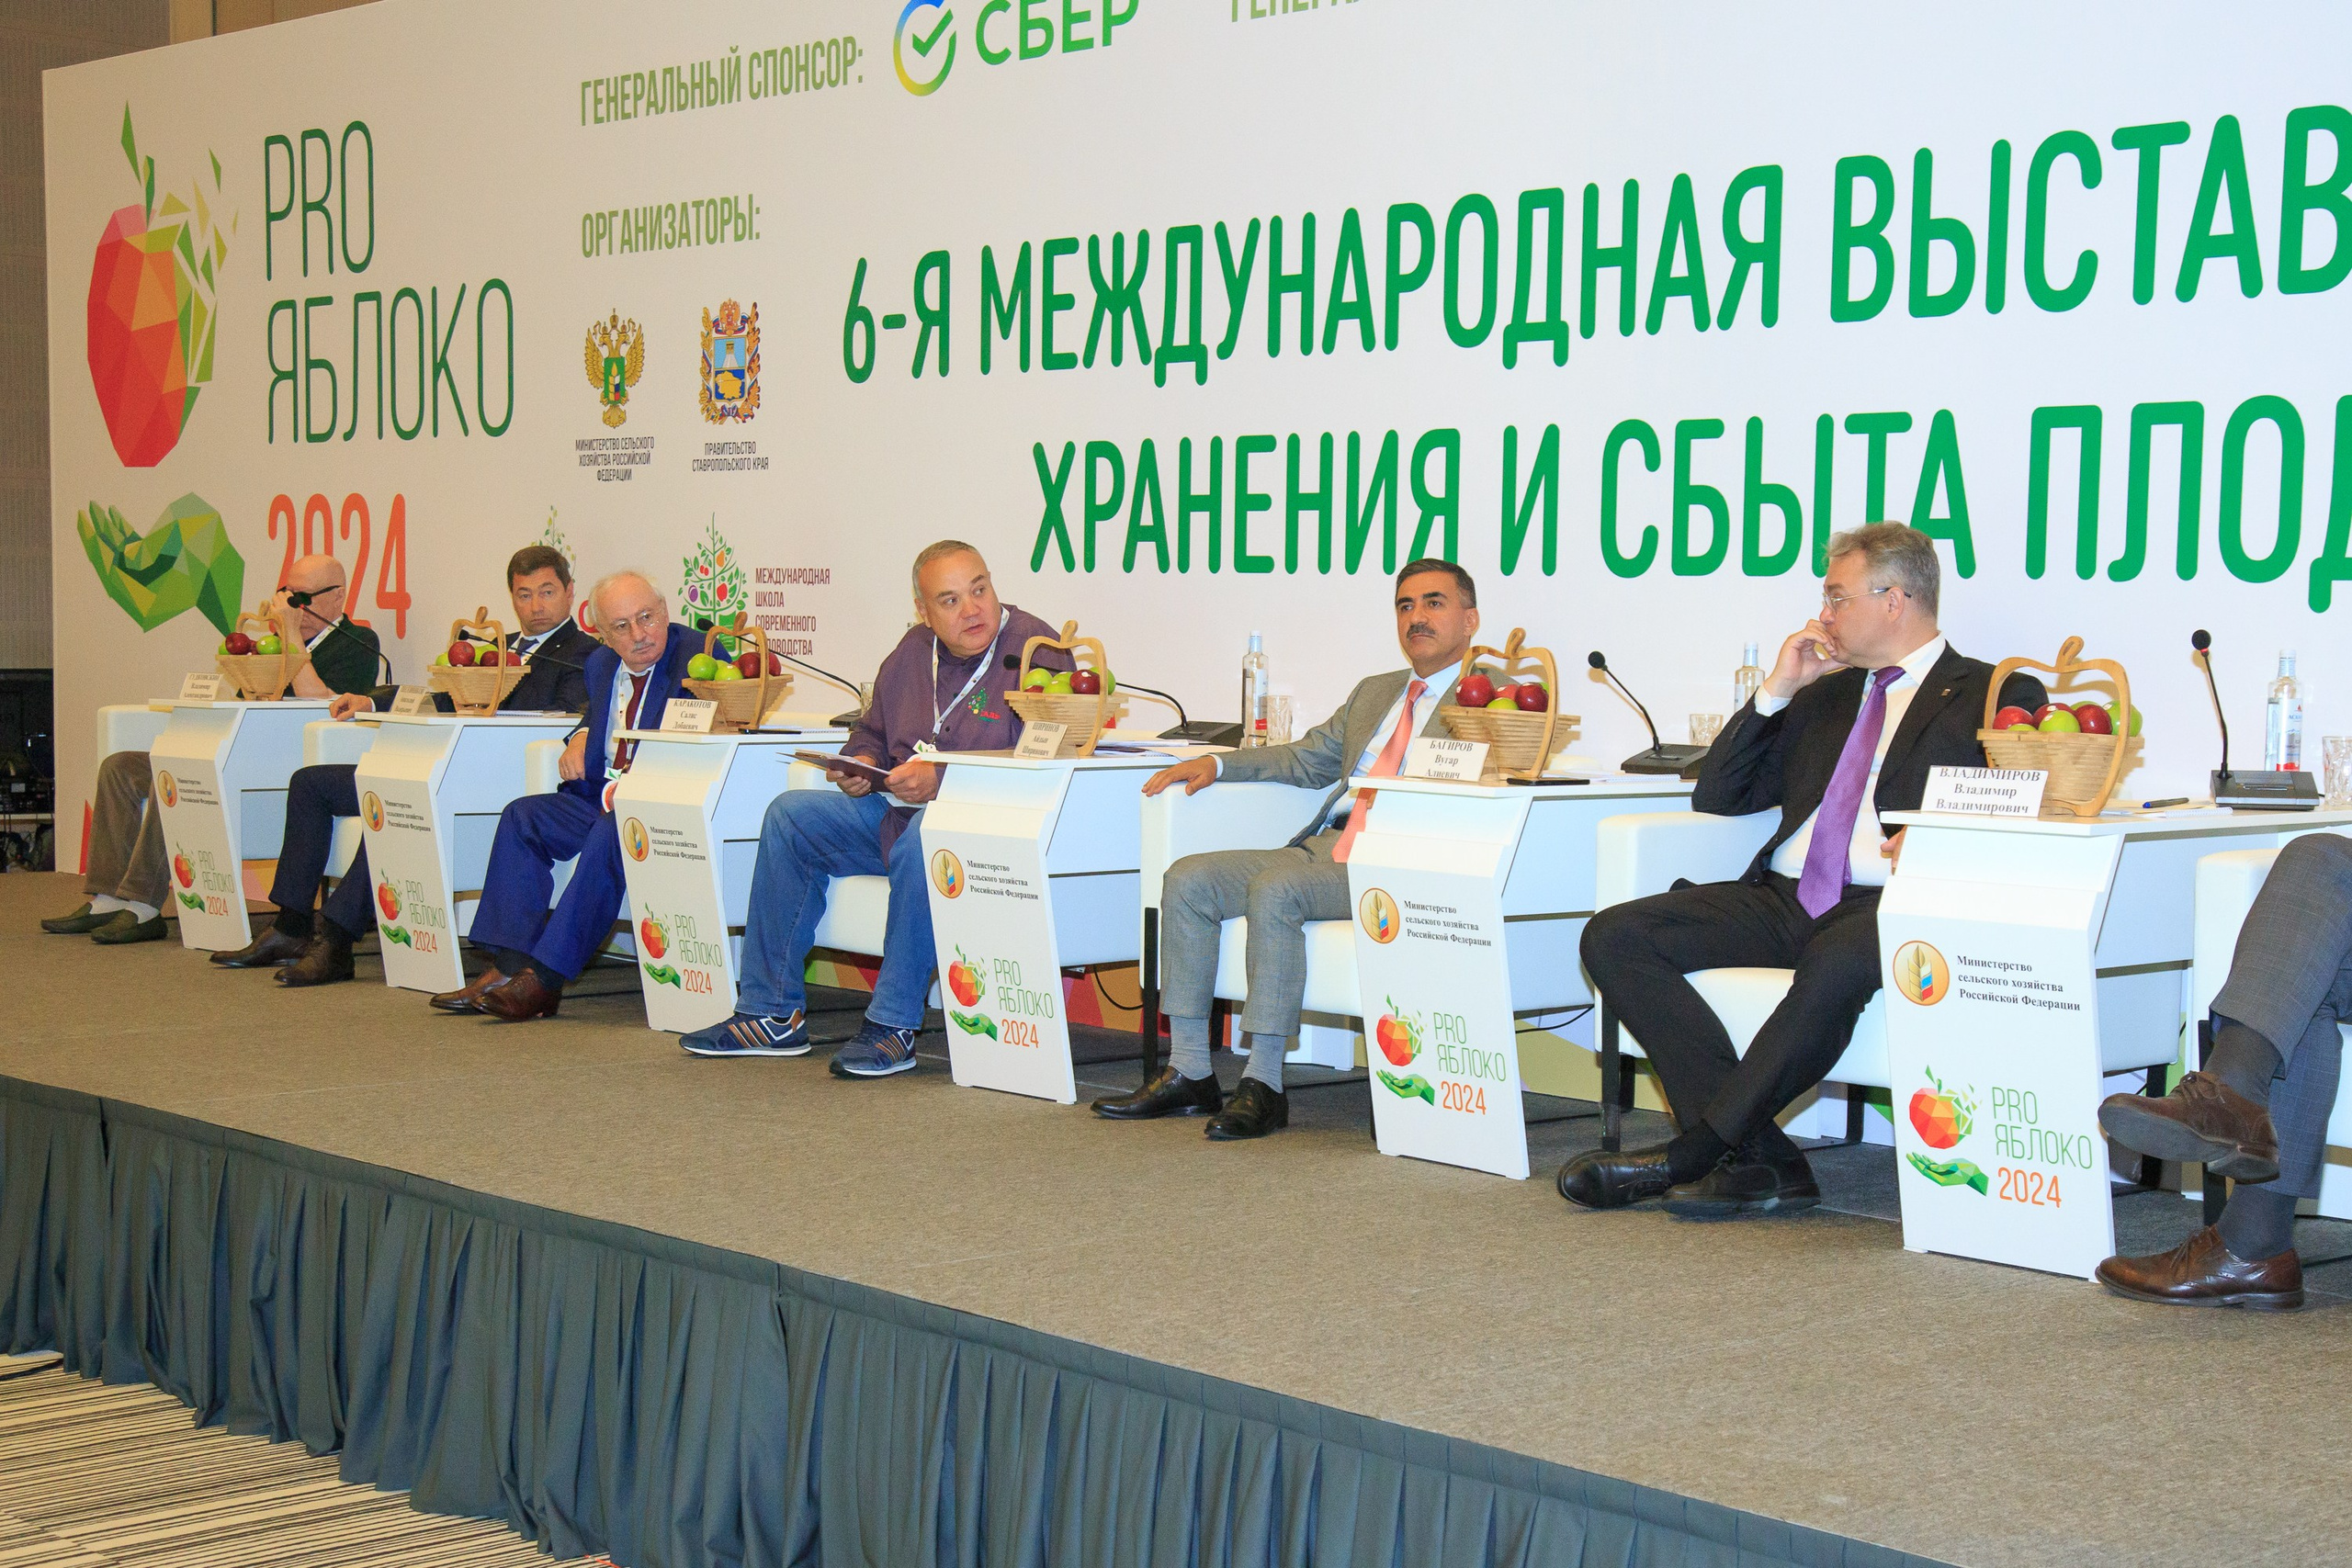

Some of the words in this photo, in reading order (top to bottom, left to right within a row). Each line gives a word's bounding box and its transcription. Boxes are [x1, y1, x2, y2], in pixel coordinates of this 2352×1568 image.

[976, 0, 1139, 65] СБЕР
[581, 46, 741, 126] ГЕНЕРАЛЬНЫЙ
[748, 36, 864, 100] СПОНСОР:
[266, 120, 375, 281] PRO
[582, 193, 761, 258] ОРГАНИЗАТОРЫ:
[842, 249, 951, 384] 6-Я
[980, 163, 1784, 389] МЕЖДУНАРОДНАЯ
[1829, 104, 2352, 322] ВЫСТАВ
[268, 277, 514, 445] ЯБЛОКО
[575, 437, 620, 451] МИНИСТЕРСТВО
[621, 436, 654, 450] СЕЛЬСКОГО
[705, 441, 756, 456] ПРАВИТЕЛЬСТВО
[579, 452, 611, 467] ХОЗЯЙСТВА
[612, 450, 651, 466] РОССИЙСКОЙ
[692, 457, 752, 472] СТАВРОПОЛЬСКОГО
[752, 457, 769, 470] КРАЯ
[597, 468, 632, 482] ФЕДЕРАЦИИ
[1030, 427, 1462, 576] ХРАНЕНИЯ
[1499, 423, 1561, 577] И
[1600, 407, 1977, 580] СБЫТА
[755, 568, 831, 586] МЕЖДУНАРОДНАЯ
[755, 591, 785, 607] ШКОЛА
[755, 615, 817, 632] СОВРЕМЕННОГО
[673, 700, 711, 709] КАРАКОТОВ
[1430, 740, 1474, 752] БАГИРОВ
[1434, 754, 1459, 767] Вугар
[1426, 769, 1461, 779] Алиевич
[1939, 767, 2041, 782] ВЛАДИМИРОВ
[1953, 783, 2018, 799] Владимир
[1936, 798, 2029, 815] Владимирович
[967, 859, 1010, 873] Министерство
[968, 874, 998, 884] сельского
[999, 876, 1028, 887] хозяйства
[406, 880, 424, 903] PRO
[970, 885, 1004, 897] Российской
[1004, 889, 1039, 901] Федерации
[409, 904, 446, 929] ЯБЛОКО
[1404, 900, 1457, 916] Министерство
[674, 914, 696, 940] PRO
[1406, 916, 1442, 929] сельского
[1442, 919, 1479, 931] хозяйства
[413, 930, 438, 953] 2024
[1407, 929, 1449, 942] Российской
[1450, 933, 1492, 948] Федерации
[679, 939, 723, 967] ЯБЛОКО
[993, 957, 1022, 987] PRO
[1957, 954, 2032, 974] Министерство
[684, 968, 713, 995] 2024
[1958, 973, 2009, 988] сельского
[2011, 977, 2064, 993] хозяйства
[998, 986, 1055, 1019] ЯБЛОКО
[1960, 987, 2018, 1005] Российской
[2021, 994, 2081, 1010] Федерации
[1001, 1018, 1039, 1049] 2024
[1433, 1011, 1467, 1044] PRO
[1437, 1043, 1507, 1082] ЯБЛОКО
[1441, 1080, 1487, 1115] 2024
[1992, 1086, 2039, 1124] PRO
[1996, 1123, 2093, 1169] ЯБЛОКО
[1997, 1167, 2063, 1208] 2024
